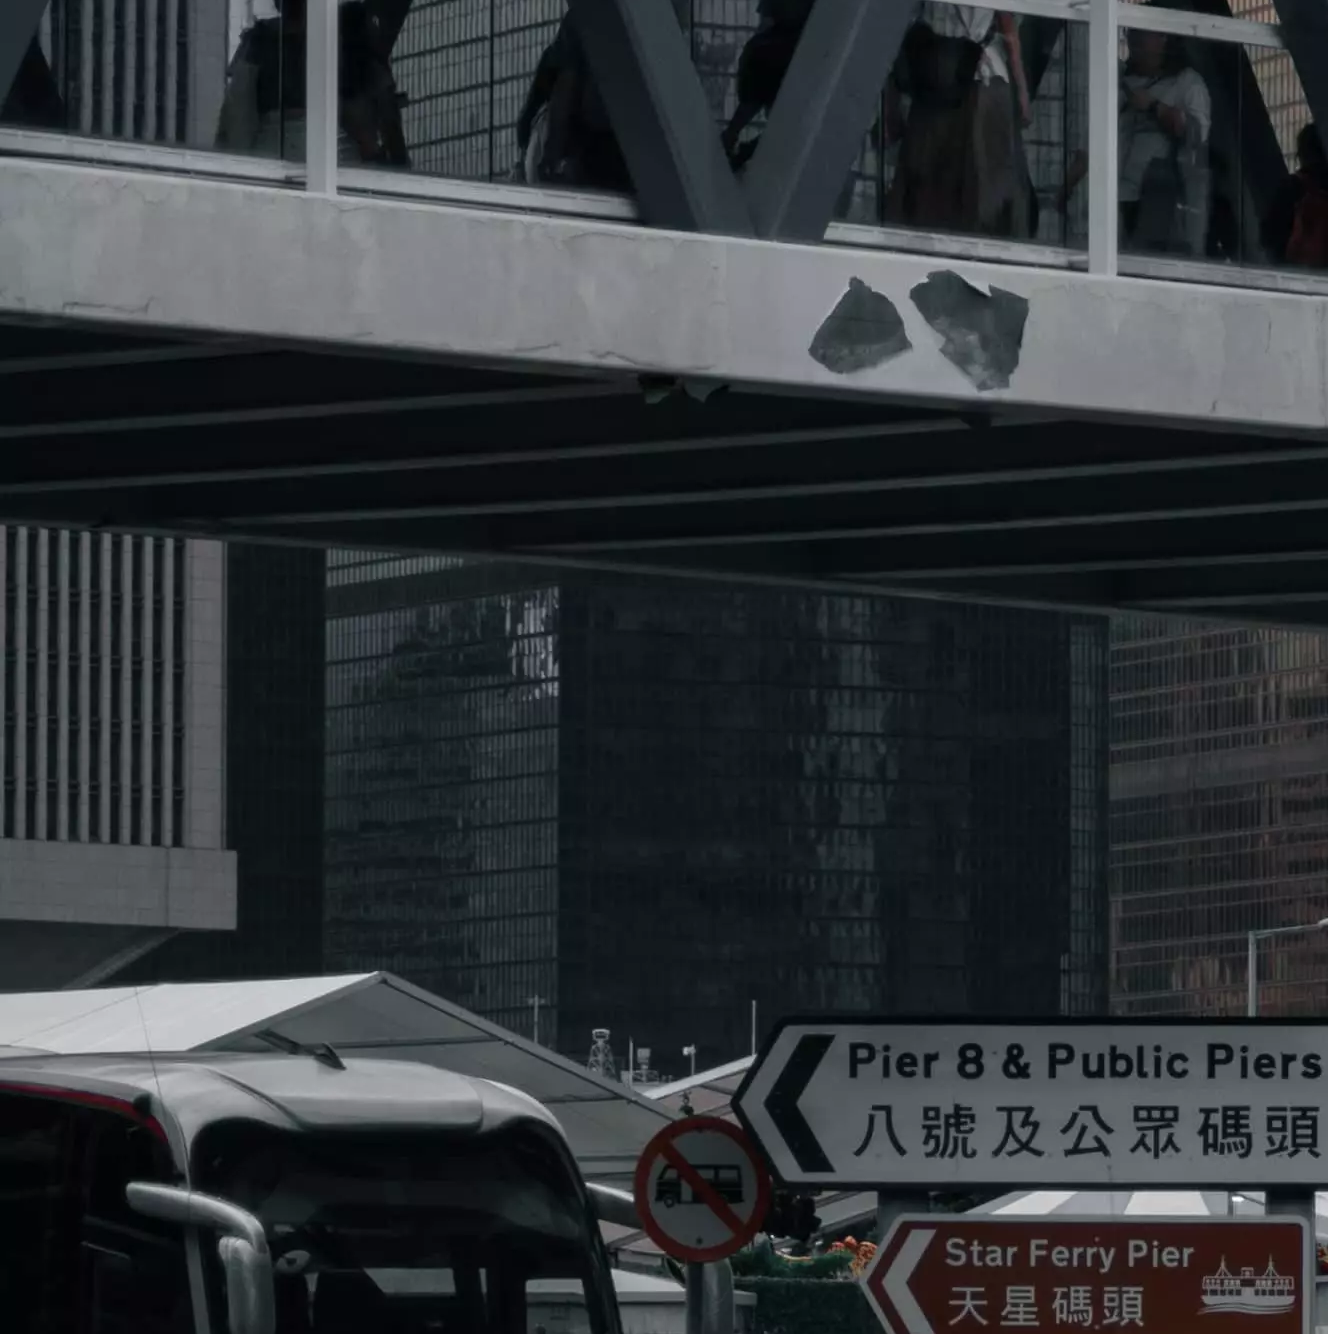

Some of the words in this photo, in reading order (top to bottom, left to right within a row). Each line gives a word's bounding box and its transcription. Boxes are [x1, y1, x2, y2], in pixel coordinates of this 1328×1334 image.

[848, 1041, 940, 1079] Pier
[956, 1042, 985, 1080] 8
[1001, 1042, 1031, 1080] &
[1047, 1042, 1189, 1080] Public
[1206, 1042, 1323, 1080] Piers
[853, 1103, 1321, 1160] 八號及公眾碼頭
[945, 1237, 1018, 1267] Star
[1029, 1237, 1116, 1273] Ferry
[1128, 1238, 1195, 1268] Pier
[948, 1285, 1144, 1330] 天星碼頭
